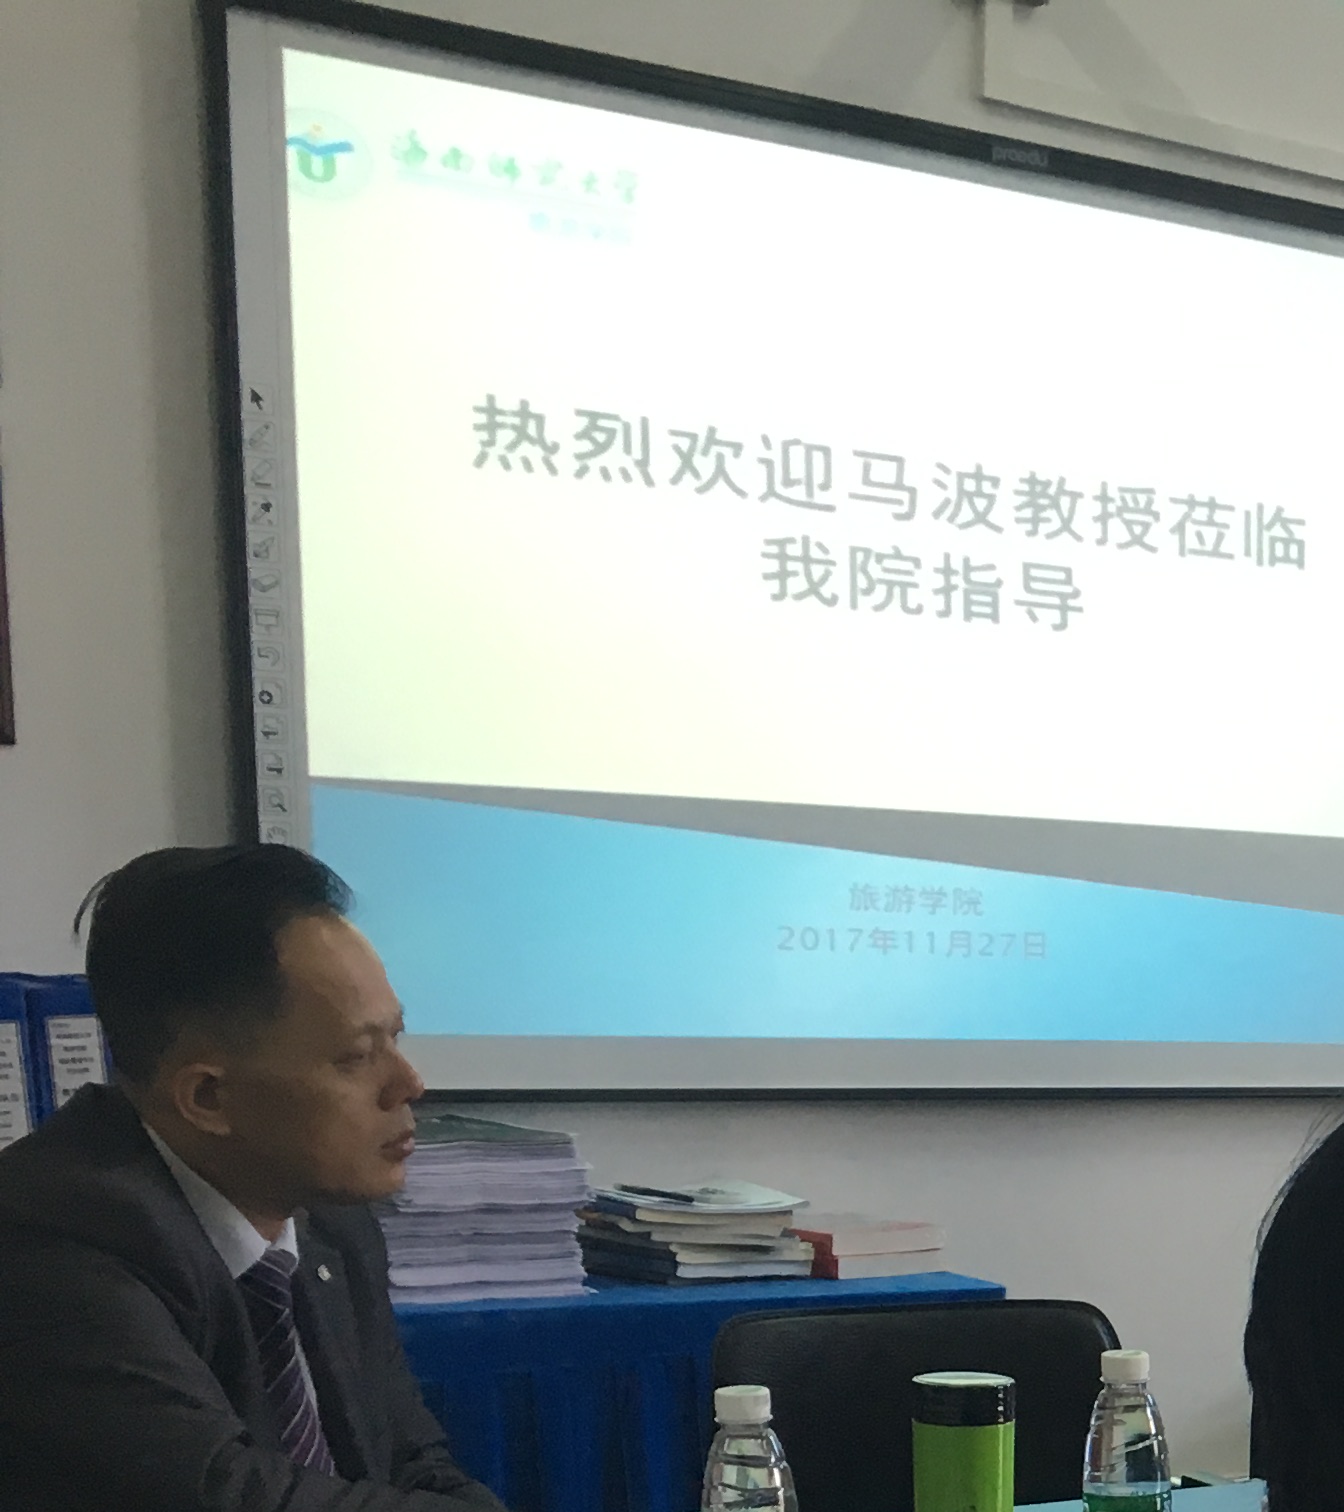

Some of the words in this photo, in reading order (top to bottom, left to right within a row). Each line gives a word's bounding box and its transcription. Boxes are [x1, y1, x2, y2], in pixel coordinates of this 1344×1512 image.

[472, 393, 1307, 569] 热烈欢迎马波教授莅临
[760, 535, 1085, 631] 我院指导
[848, 882, 985, 917] 旅游学院
[776, 925, 1047, 960] 2017年11月27日
